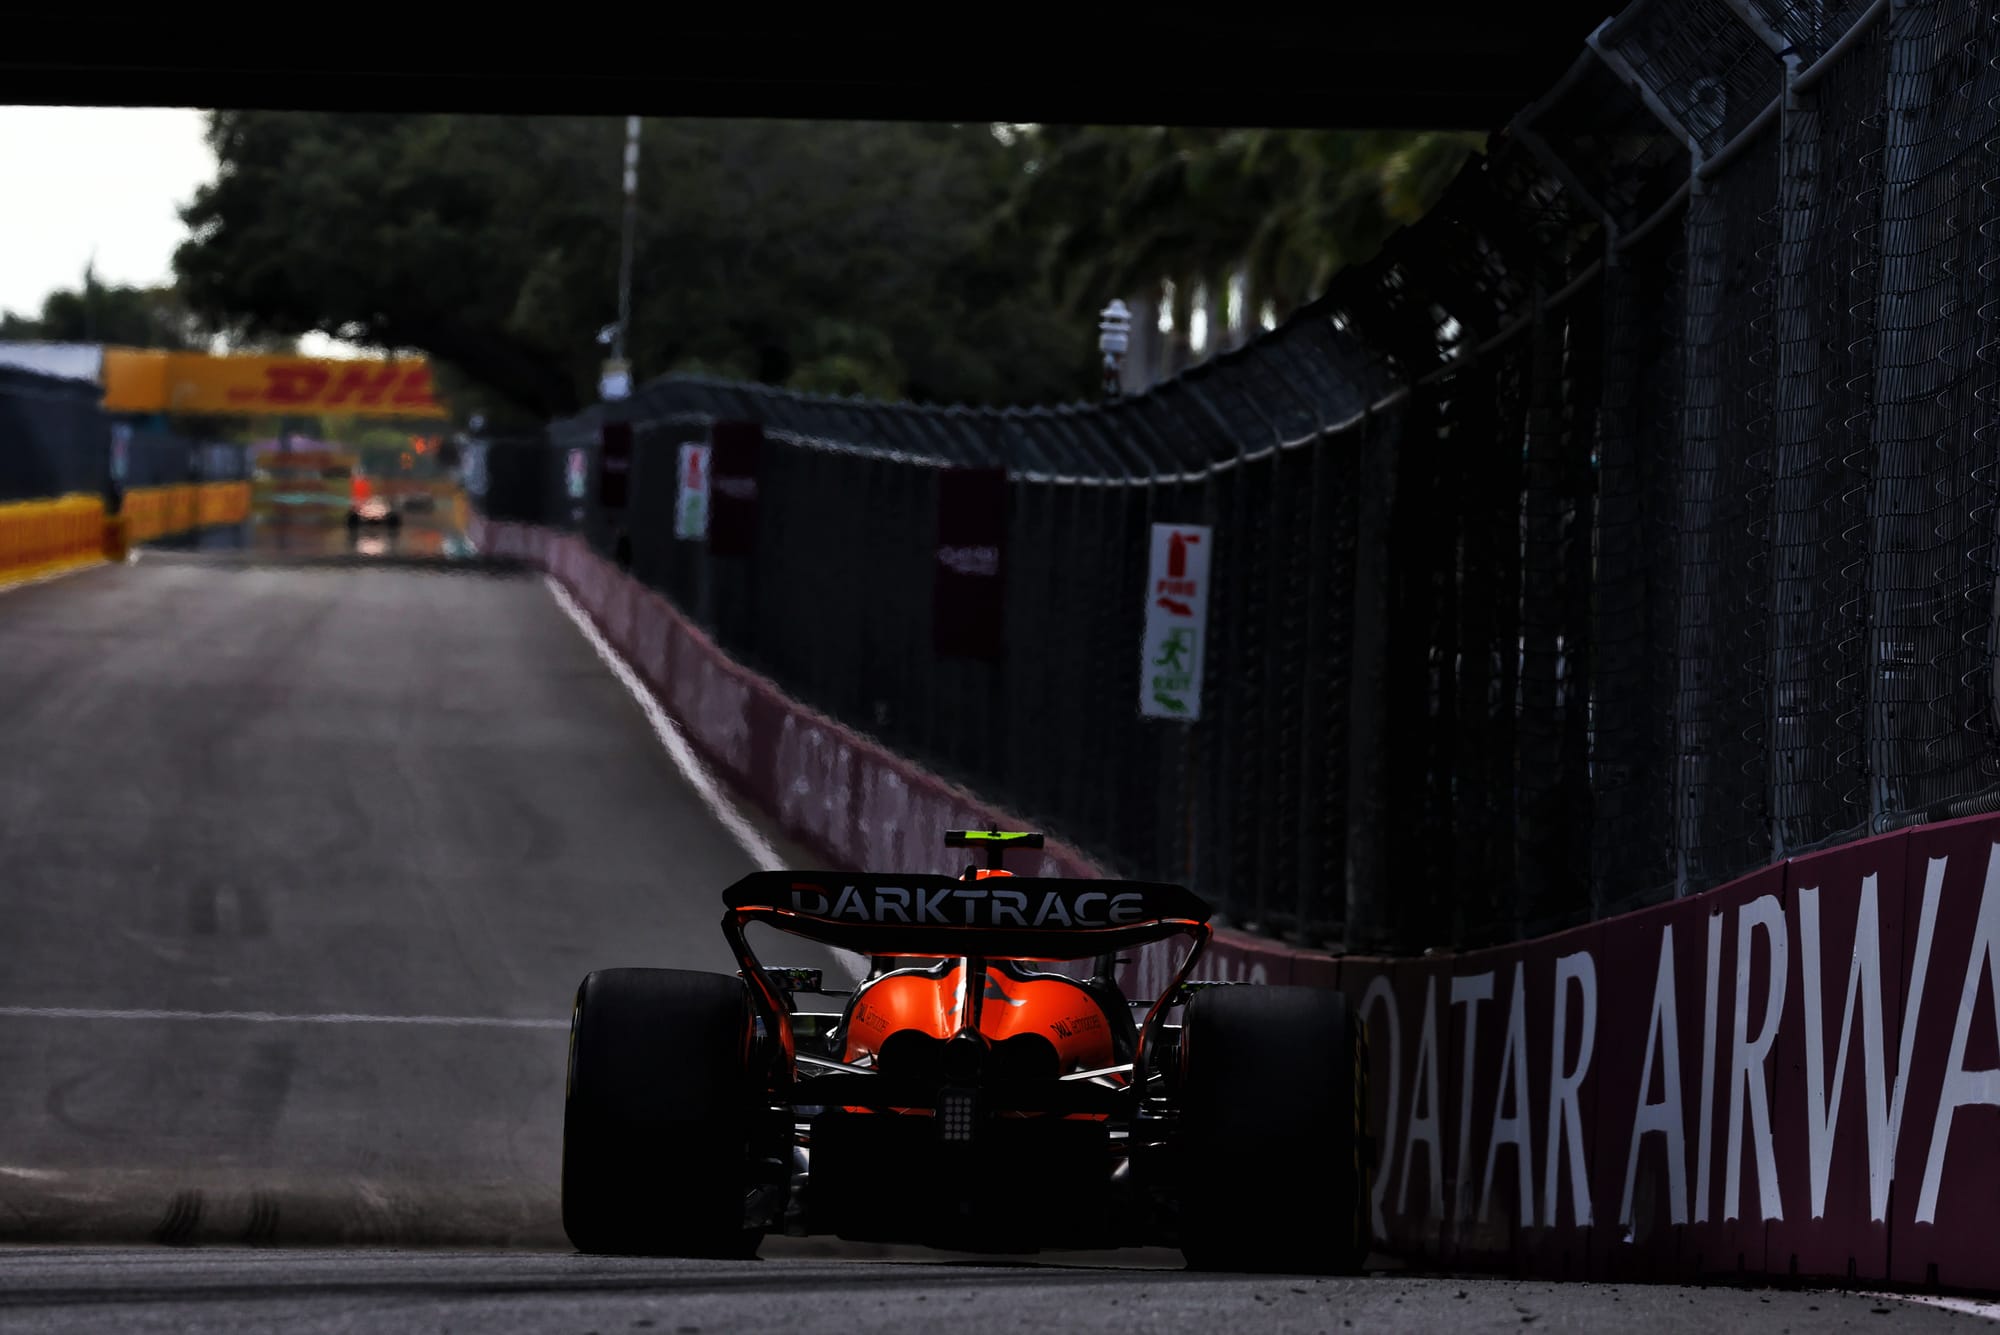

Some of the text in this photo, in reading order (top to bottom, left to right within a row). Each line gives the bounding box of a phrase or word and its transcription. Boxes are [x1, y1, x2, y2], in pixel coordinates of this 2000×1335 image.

[266, 366, 436, 404] DHL
[1157, 580, 1197, 597] FIRE
[791, 882, 1144, 928] DARKTRACE
